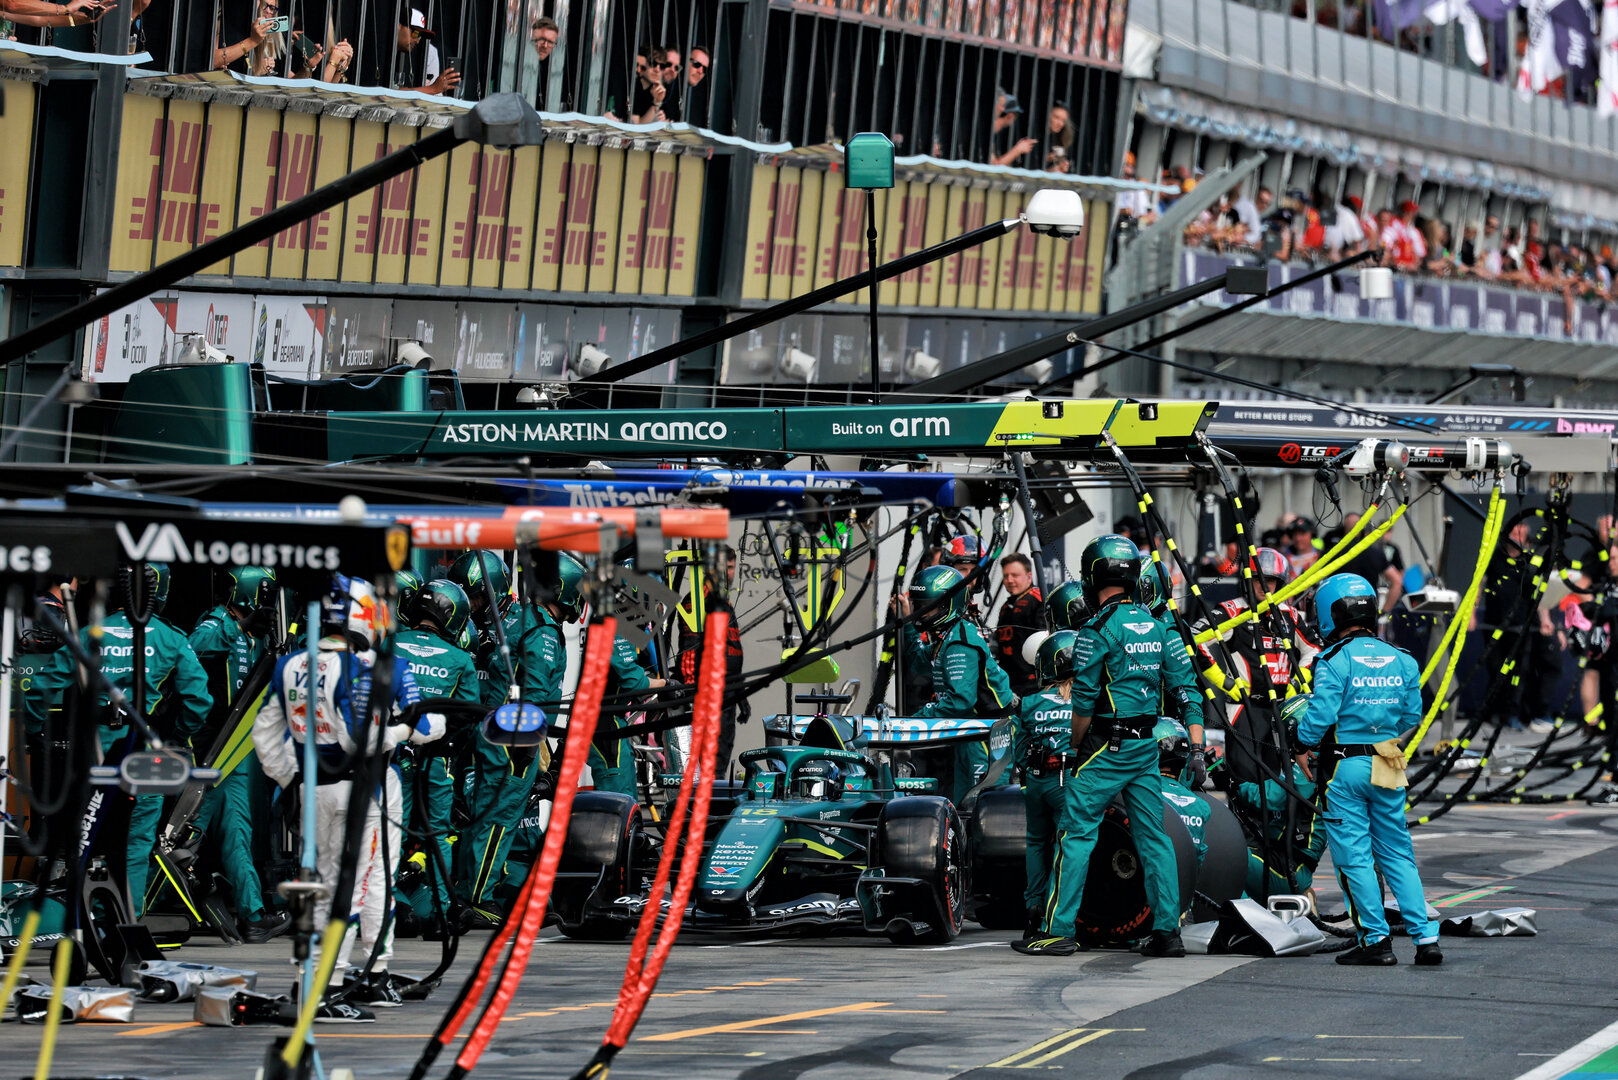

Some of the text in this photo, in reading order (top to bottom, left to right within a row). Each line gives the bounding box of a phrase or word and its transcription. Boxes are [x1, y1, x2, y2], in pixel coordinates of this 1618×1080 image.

[129, 118, 220, 245] DHL
[452, 151, 523, 263] DHL
[543, 161, 607, 266] DHL
[625, 169, 685, 270] DHL
[754, 181, 807, 277] DHL
[1234, 410, 1314, 422] BETTER NEVER STOPS
[1350, 413, 1389, 428] MSC
[1443, 415, 1504, 425] ALPINE
[443, 421, 727, 442] ASTON MARTIN aramco
[832, 416, 951, 438] Built on arm
[1301, 445, 1341, 457] TGR
[411, 520, 484, 544] Gulf
[195, 539, 340, 570] LOGISTICS
[1124, 641, 1162, 653] aramco
[408, 662, 449, 679] amco
[1352, 675, 1403, 688] aramco
[417, 686, 443, 695] nda
[1034, 709, 1073, 721] aram
[830, 750, 859, 760] BREITLING
[898, 781, 926, 789] BOSS
[740, 808, 779, 816] 18
